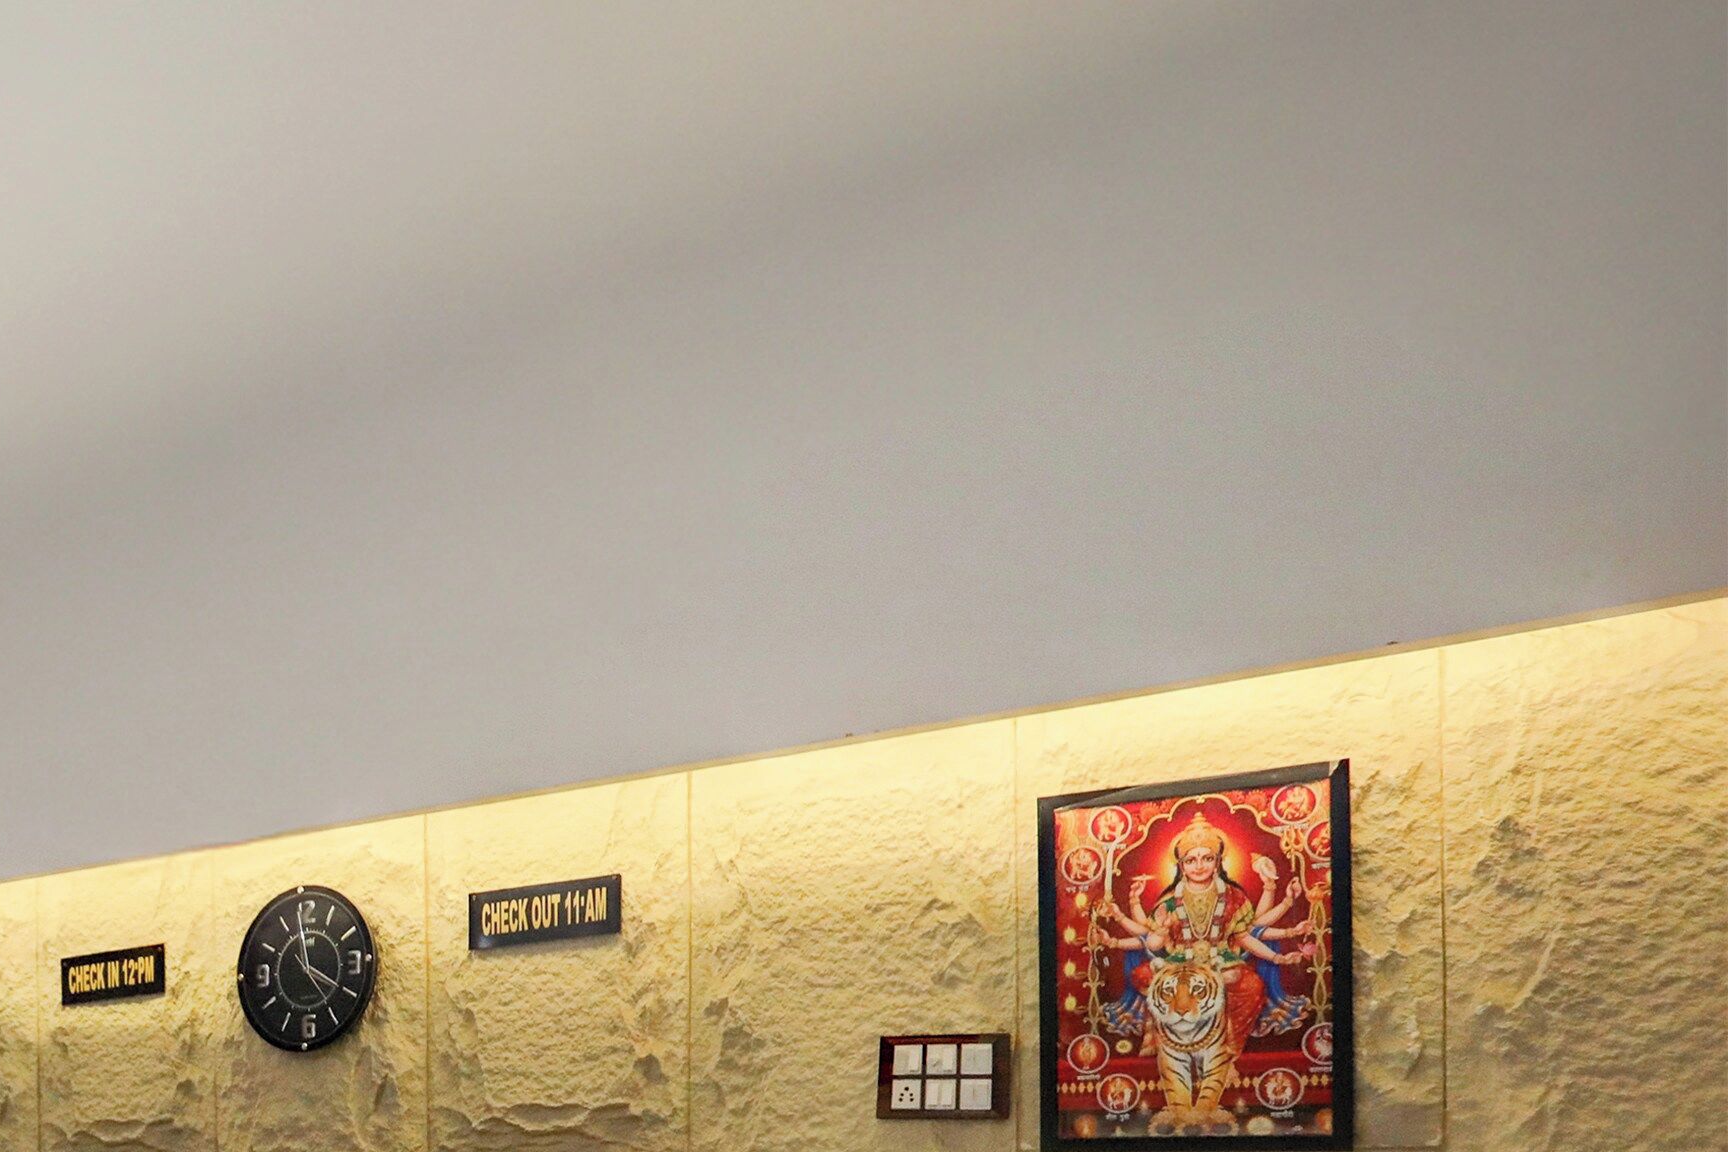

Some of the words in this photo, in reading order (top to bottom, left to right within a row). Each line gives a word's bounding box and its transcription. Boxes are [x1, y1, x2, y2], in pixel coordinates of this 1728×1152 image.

[481, 898, 529, 937] CHECK
[531, 893, 561, 929] OUT
[347, 949, 362, 975] 3
[68, 962, 105, 994] CHECK
[107, 960, 119, 988] IN
[256, 963, 271, 988] 9
[301, 1013, 317, 1038] 6
